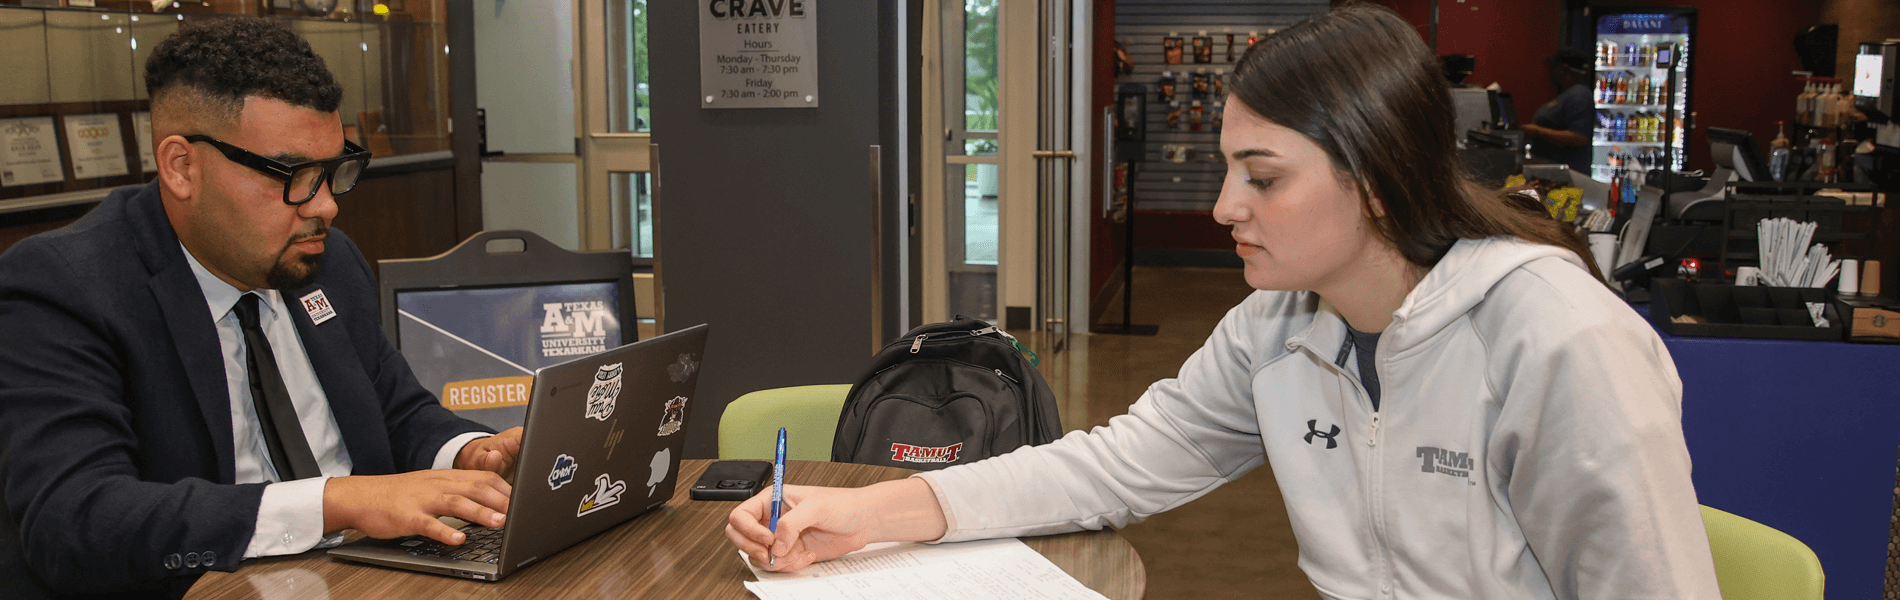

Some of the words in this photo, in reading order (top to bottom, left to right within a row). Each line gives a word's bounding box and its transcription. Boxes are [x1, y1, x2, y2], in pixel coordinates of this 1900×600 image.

[710, 0, 805, 19] CRAVE
[737, 23, 779, 34] EATERY
[744, 40, 772, 49] Hours
[717, 55, 753, 65] Monday
[760, 54, 801, 65] Thursday
[720, 65, 738, 74] 7:30
[763, 65, 781, 74] 7:30
[783, 66, 798, 75] pm
[746, 78, 773, 89] Friday
[721, 90, 739, 98] 7:30
[763, 89, 781, 98] 2:00
[783, 91, 799, 99] pm
[564, 301, 604, 312] TEXAS
[542, 337, 606, 348] UNIVERSITY
[542, 345, 606, 357] TEXARKANA
[449, 383, 527, 406] REGISTER
[890, 442, 963, 463] TAMUT
